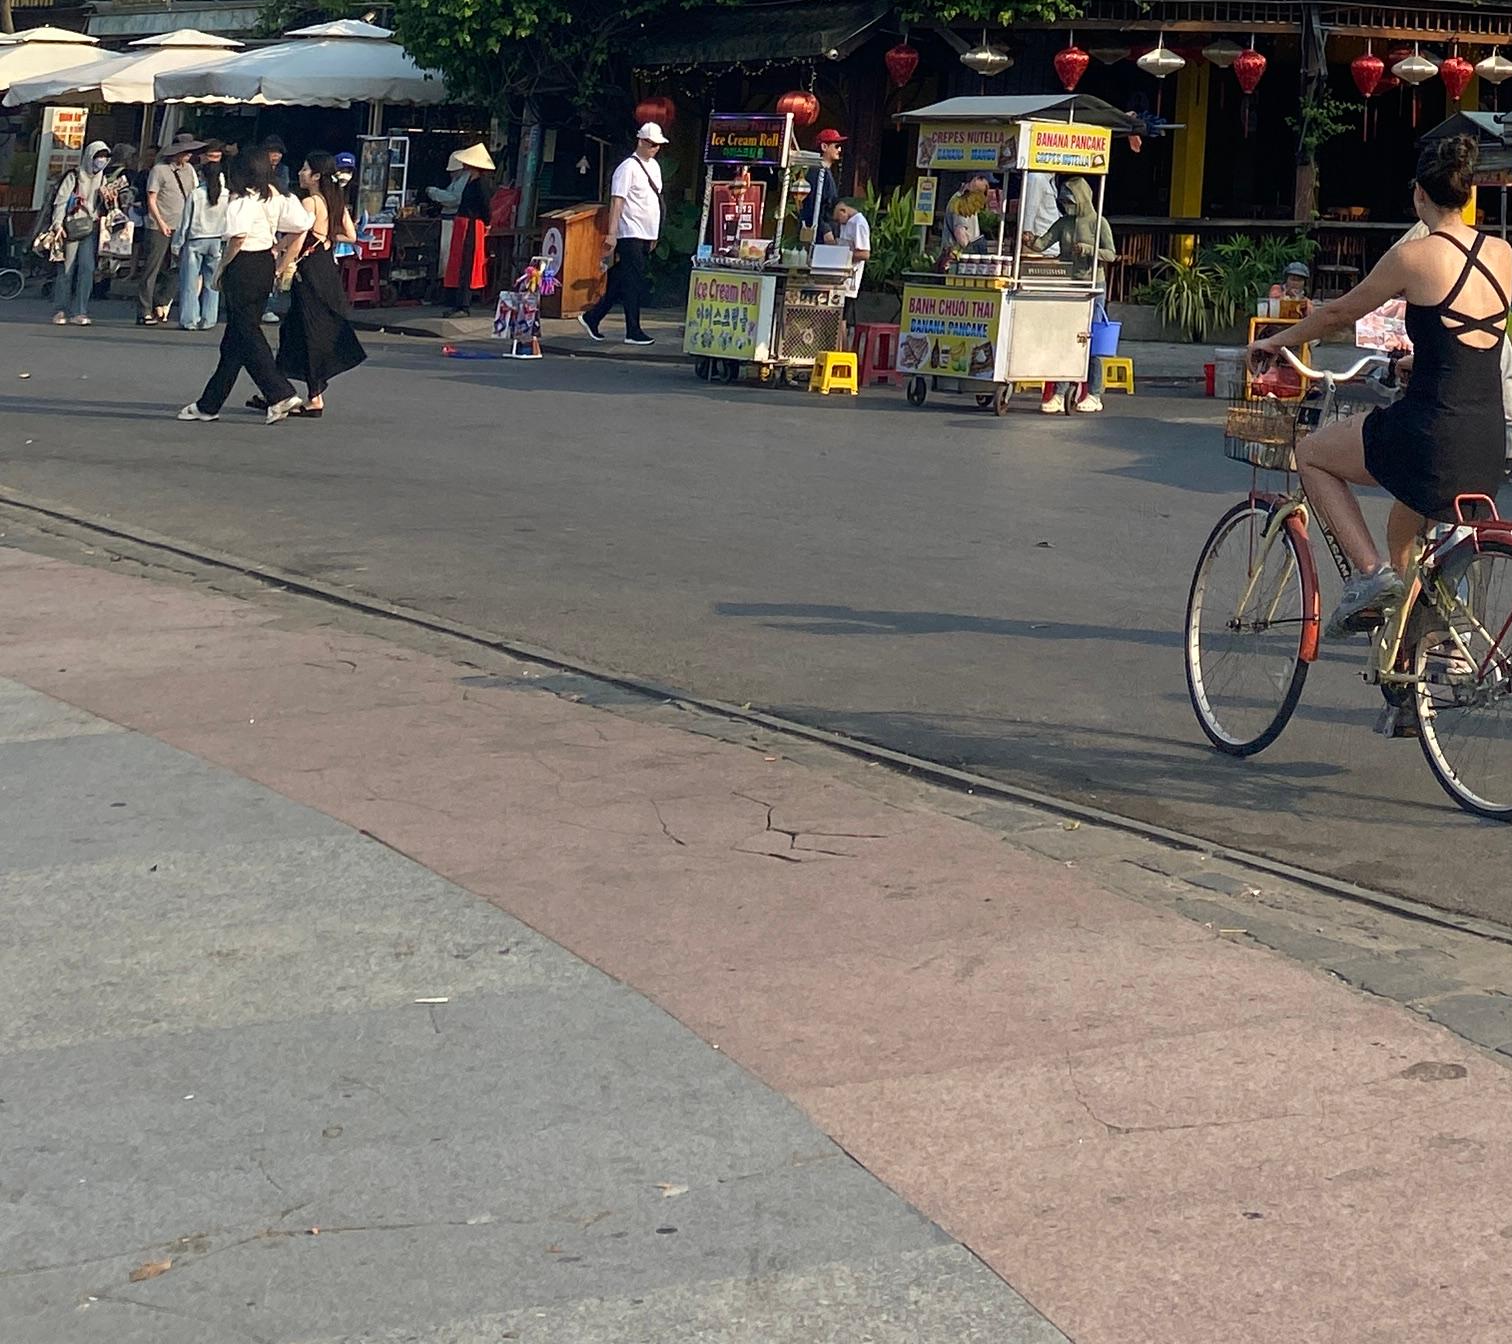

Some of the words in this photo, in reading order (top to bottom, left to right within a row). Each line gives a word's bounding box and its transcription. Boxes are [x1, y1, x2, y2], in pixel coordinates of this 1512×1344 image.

[711, 132, 726, 146] Ice
[727, 133, 758, 147] Cream
[759, 133, 780, 147] Roll
[931, 130, 964, 144] CREPES
[967, 131, 1005, 144] NUTELLA
[1036, 132, 1069, 148] BANANA
[1070, 134, 1106, 151] PANCAKE
[1035, 152, 1061, 165] CREPES
[1062, 154, 1090, 167] NUTELLA
[694, 277, 708, 300] Ice
[709, 278, 740, 303] Cream
[740, 281, 758, 305] Roll
[911, 318, 945, 335] BANANA
[948, 321, 988, 338] PANCAKE
